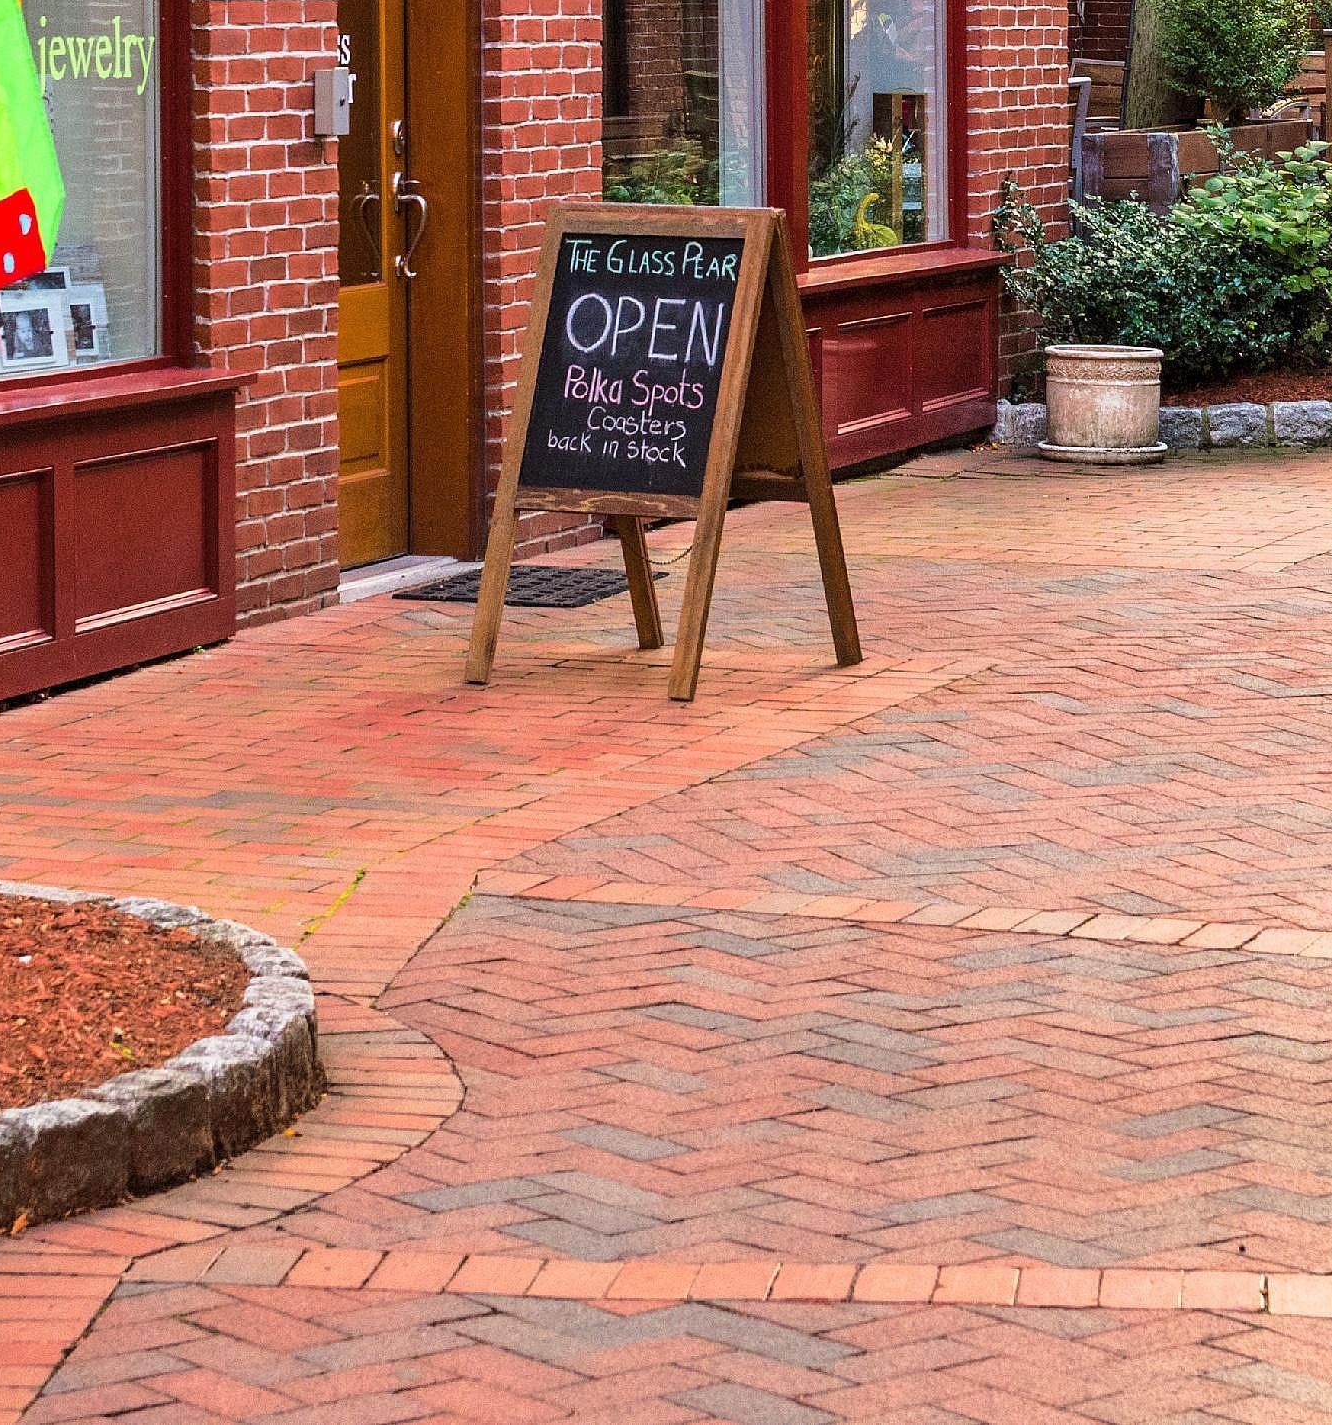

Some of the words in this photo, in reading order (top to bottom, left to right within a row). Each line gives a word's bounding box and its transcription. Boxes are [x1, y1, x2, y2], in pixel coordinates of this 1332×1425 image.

[38, 15, 155, 96] jewelry
[567, 239, 600, 273] THE
[606, 240, 675, 276] GLASS
[682, 241, 738, 281] PEAR
[566, 292, 724, 367] OPEN
[563, 365, 622, 405] Polka
[632, 369, 704, 416] Spots
[586, 406, 687, 441] Coasters
[547, 430, 592, 453] back
[602, 440, 619, 459] in
[627, 440, 687, 469] stock
